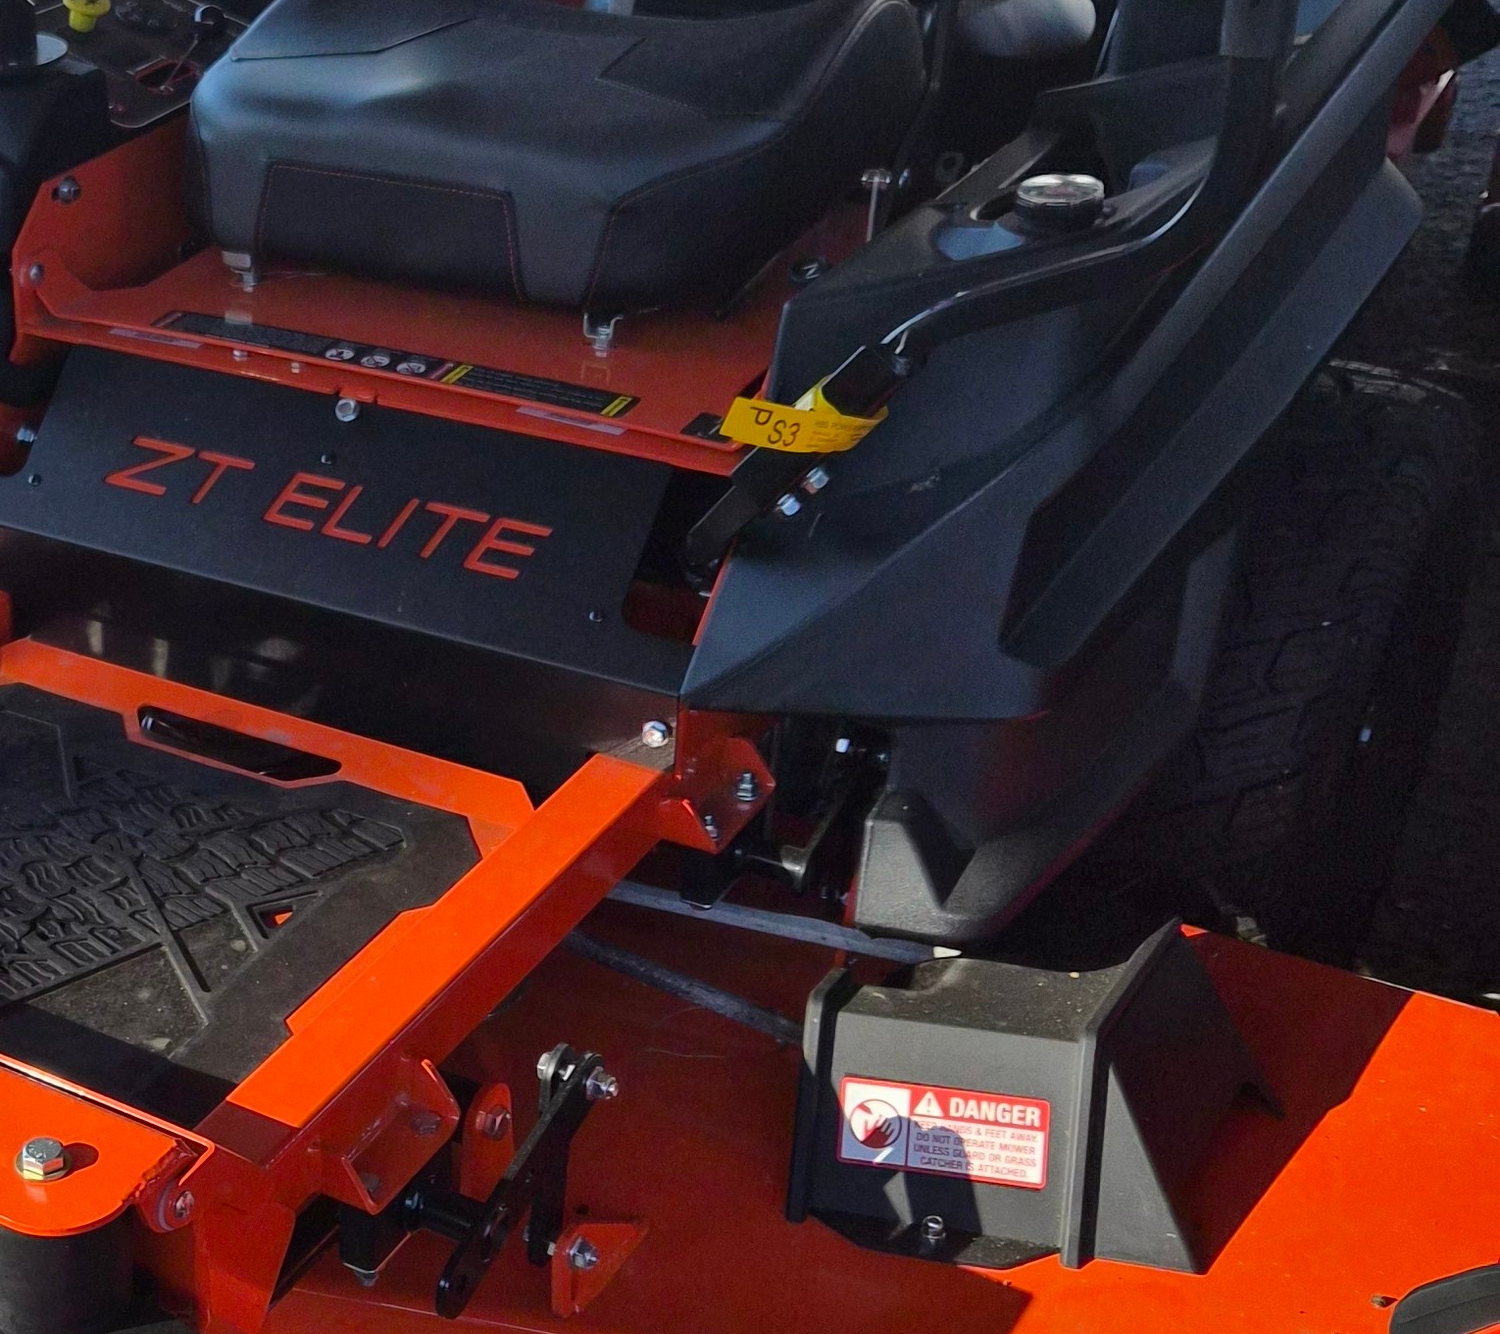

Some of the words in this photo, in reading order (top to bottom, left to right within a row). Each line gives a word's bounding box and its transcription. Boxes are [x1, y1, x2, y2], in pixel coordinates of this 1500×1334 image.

[104, 435, 256, 504] ZT
[263, 472, 554, 580] ELITE
[950, 1096, 1041, 1128] DANGER
[916, 1131, 930, 1142] DO
[931, 1133, 951, 1144] NOT
[953, 1135, 996, 1150] OPERATE
[998, 1142, 1036, 1155] MOWER
[984, 1127, 1008, 1138] FEET
[913, 1144, 950, 1157] UNLESS
[952, 1147, 986, 1161] GUARD
[988, 1152, 1002, 1163] OR
[1004, 1153, 1037, 1167] GRASS
[920, 1155, 963, 1170] CATCHER
[965, 1161, 974, 1172] IS
